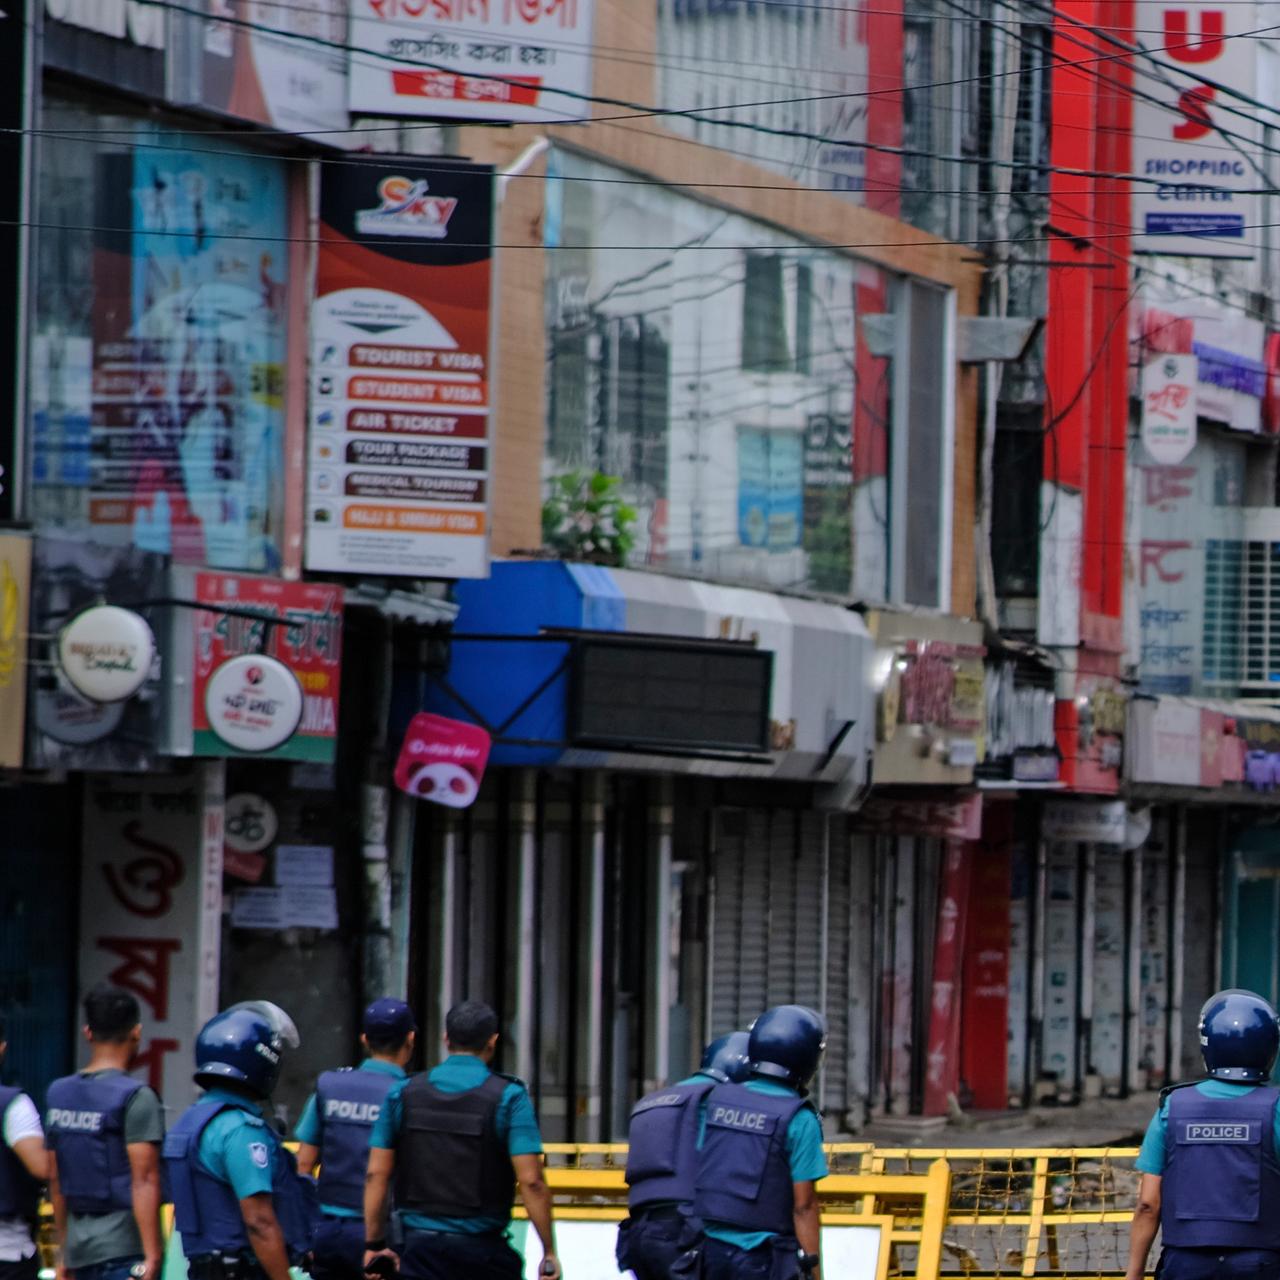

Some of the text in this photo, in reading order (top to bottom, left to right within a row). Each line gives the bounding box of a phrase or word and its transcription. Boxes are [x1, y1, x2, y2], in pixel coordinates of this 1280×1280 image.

[1145, 159, 1244, 177] SHOPPING
[355, 347, 484, 369] TOURIST VISA
[354, 380, 483, 401] STUDENT VISA
[353, 410, 459, 432] AIR TICKET
[353, 441, 469, 459] TOUR PACKAGE
[48, 1108, 101, 1132] POLICE
[325, 1099, 381, 1123] POLIC
[715, 1107, 767, 1131] POLICE
[1191, 1126, 1243, 1139] POLICE
